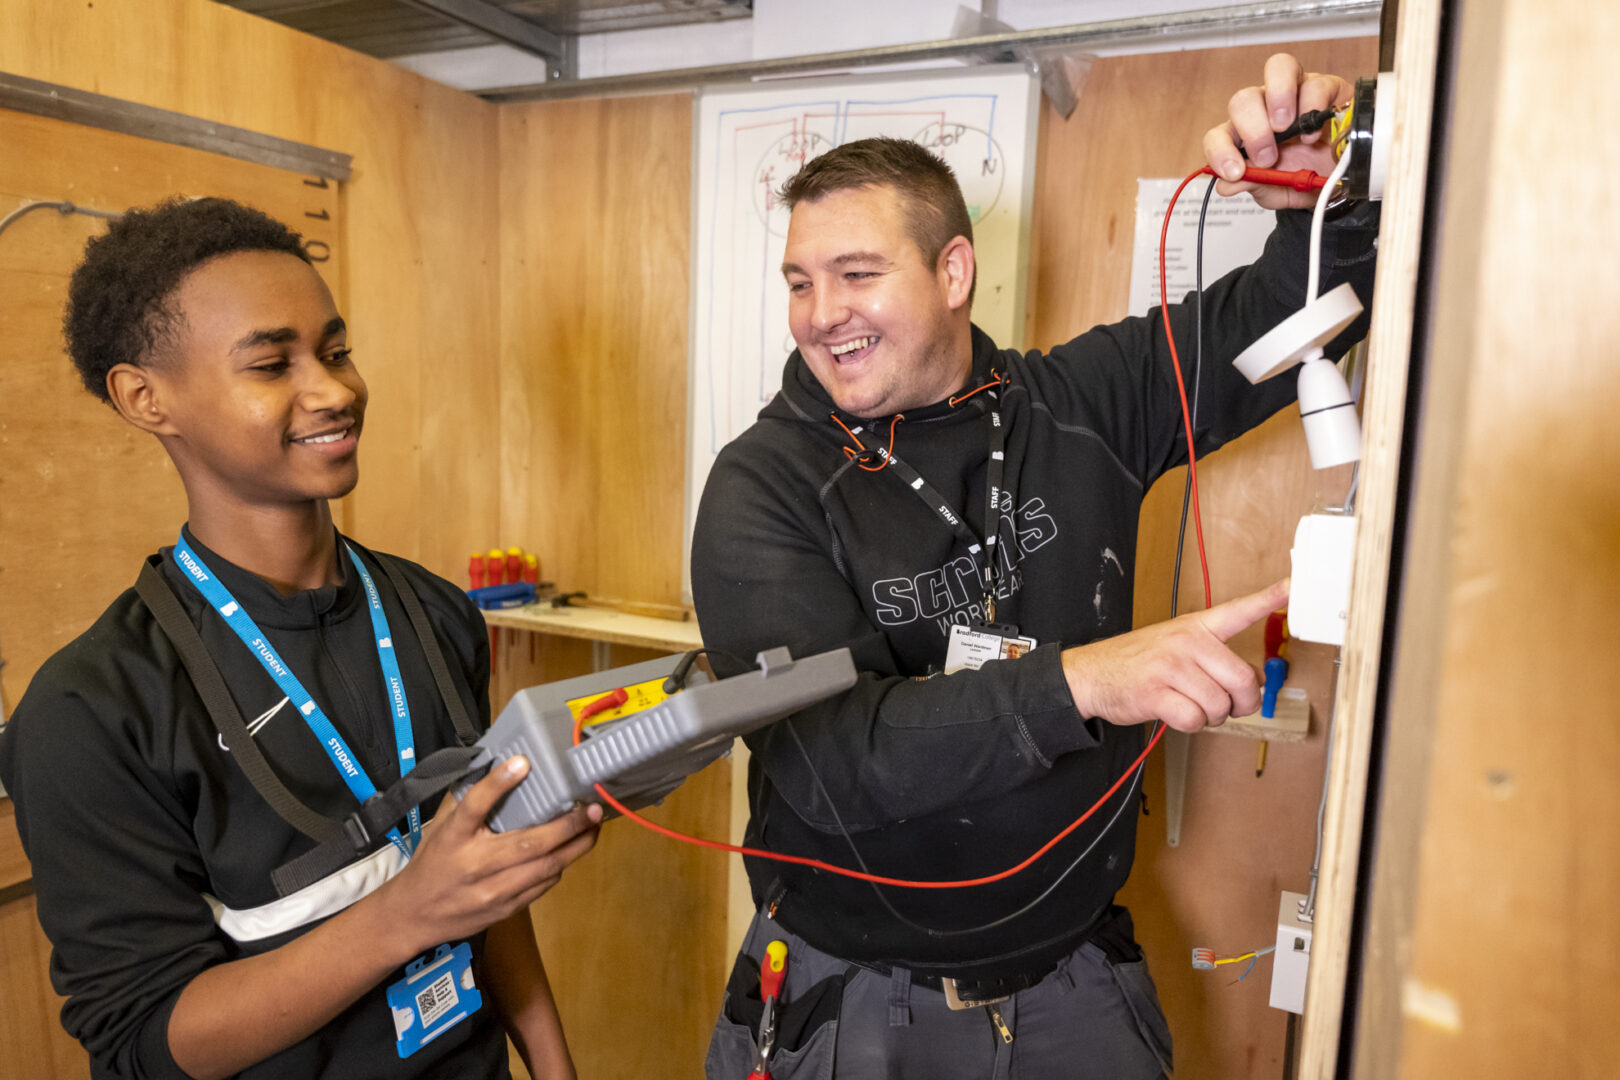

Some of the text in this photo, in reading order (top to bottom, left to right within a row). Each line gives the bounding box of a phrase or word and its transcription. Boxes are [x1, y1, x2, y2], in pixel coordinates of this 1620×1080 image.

[938, 505, 959, 526] STAFF
[990, 486, 999, 509] STAFF
[179, 550, 209, 582] STUDENT
[363, 573, 380, 609] STUDENT
[252, 638, 287, 677] STUDENT
[390, 676, 407, 718] STUDENT
[328, 737, 359, 777] STUDENT
